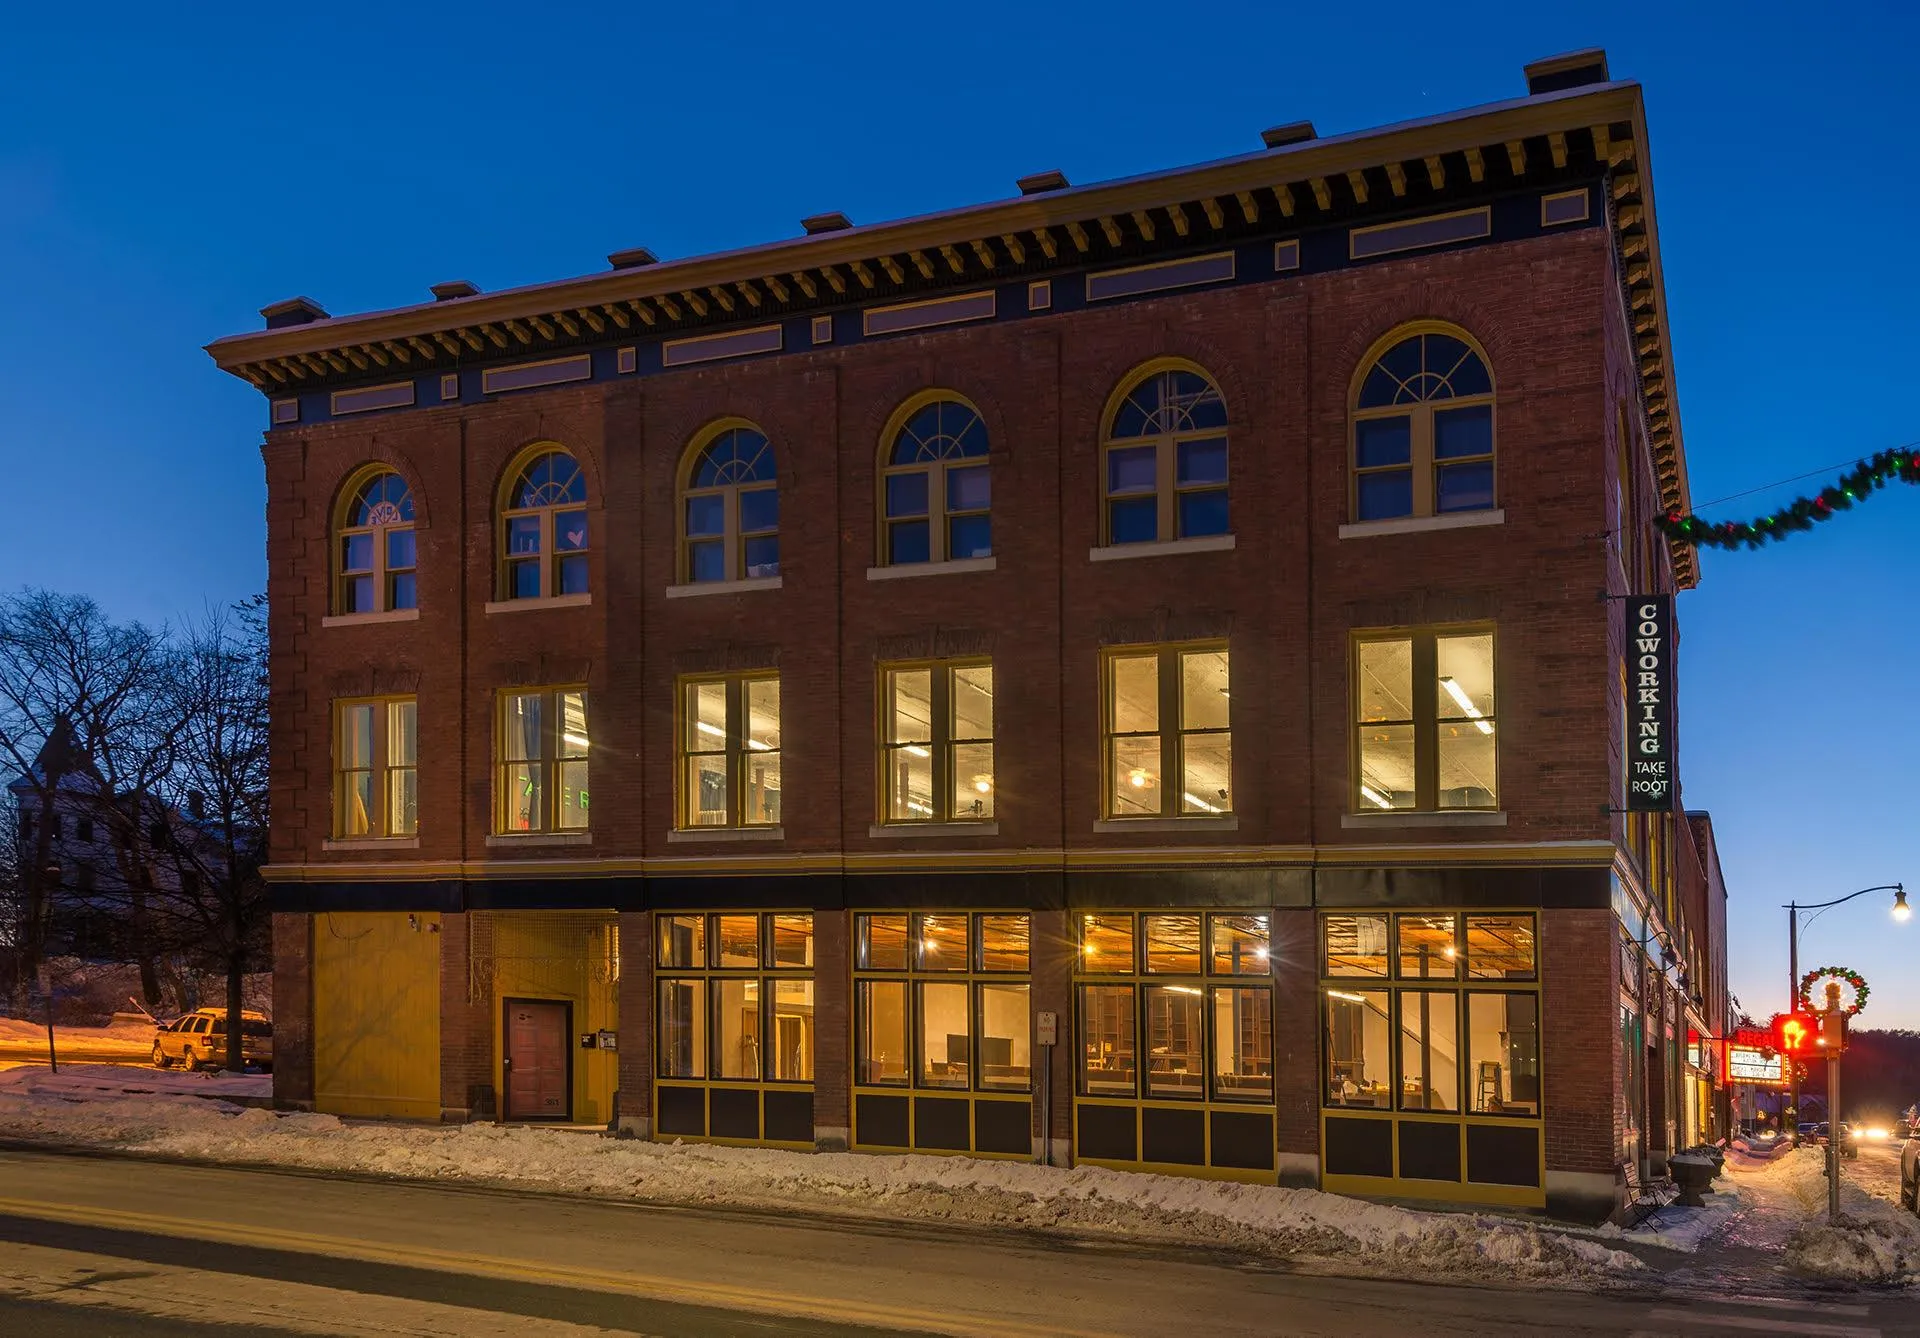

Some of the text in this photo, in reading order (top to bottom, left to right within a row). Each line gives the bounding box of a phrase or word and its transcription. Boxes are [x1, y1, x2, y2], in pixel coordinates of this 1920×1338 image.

[1636, 604, 1661, 754] COWORKING
[1634, 761, 1666, 774] TAKE
[1632, 780, 1669, 793] ROOT
